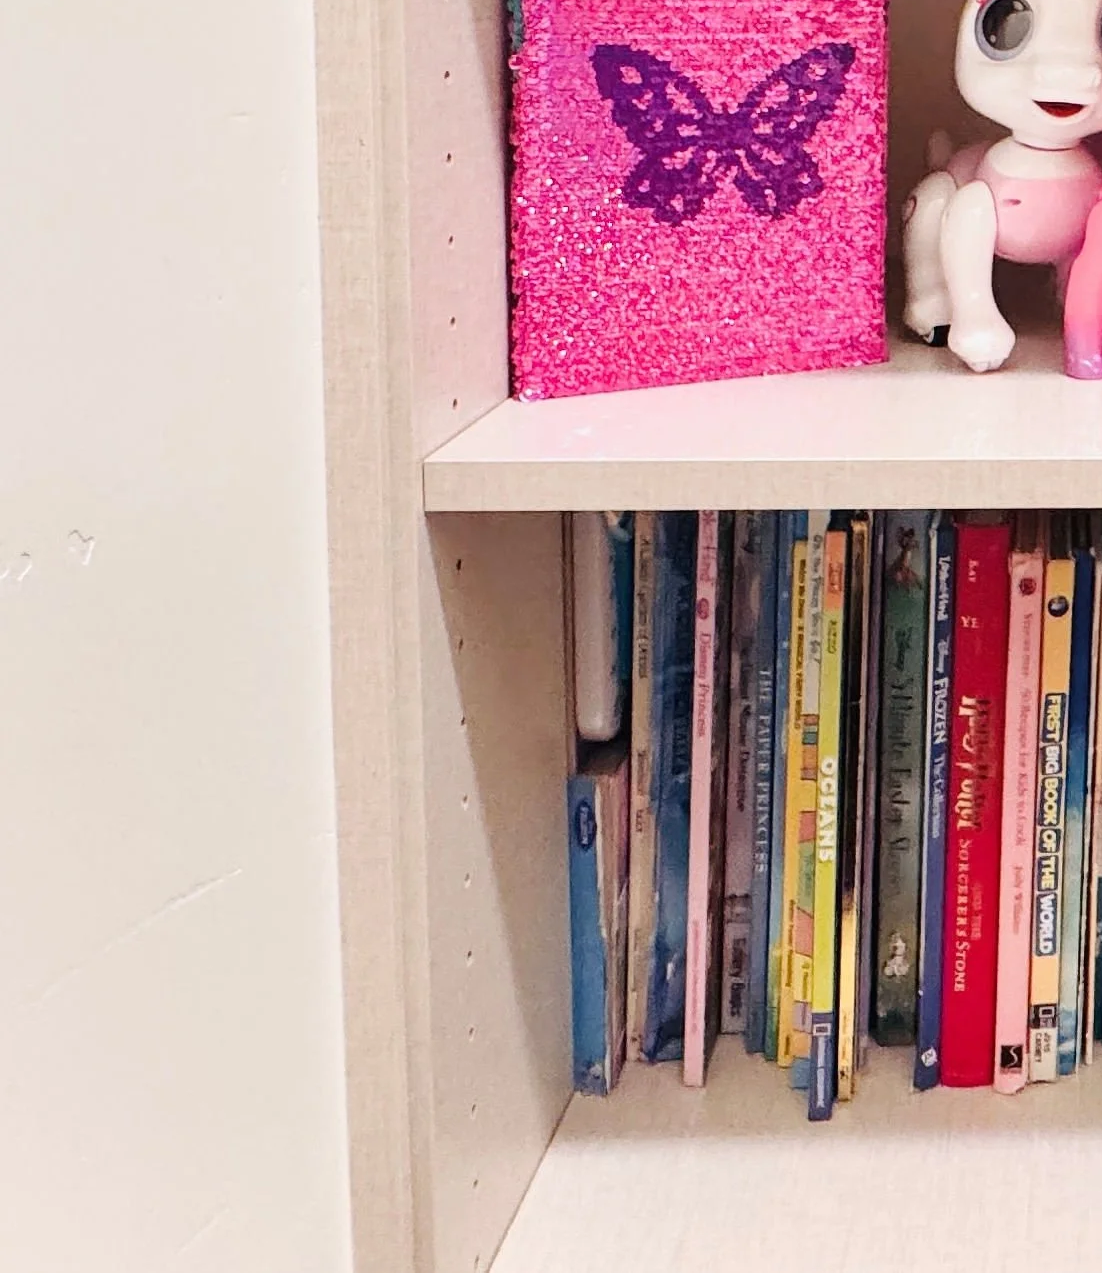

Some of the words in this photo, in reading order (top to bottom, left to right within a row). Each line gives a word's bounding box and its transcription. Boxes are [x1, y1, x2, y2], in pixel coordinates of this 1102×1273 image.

[758, 670, 773, 704] THE
[932, 677, 949, 745] FROZEN
[1045, 695, 1063, 741] FIRST
[757, 715, 772, 772] PAPER
[1044, 745, 1060, 774] BIG
[818, 756, 838, 863] OCEANS
[1043, 778, 1059, 826] BOOK
[755, 782, 771, 873] PRINCESS
[1041, 830, 1057, 852] OF
[1039, 857, 1055, 890] THE
[1038, 894, 1055, 955] WORLD
[954, 941, 970, 992] STONE
